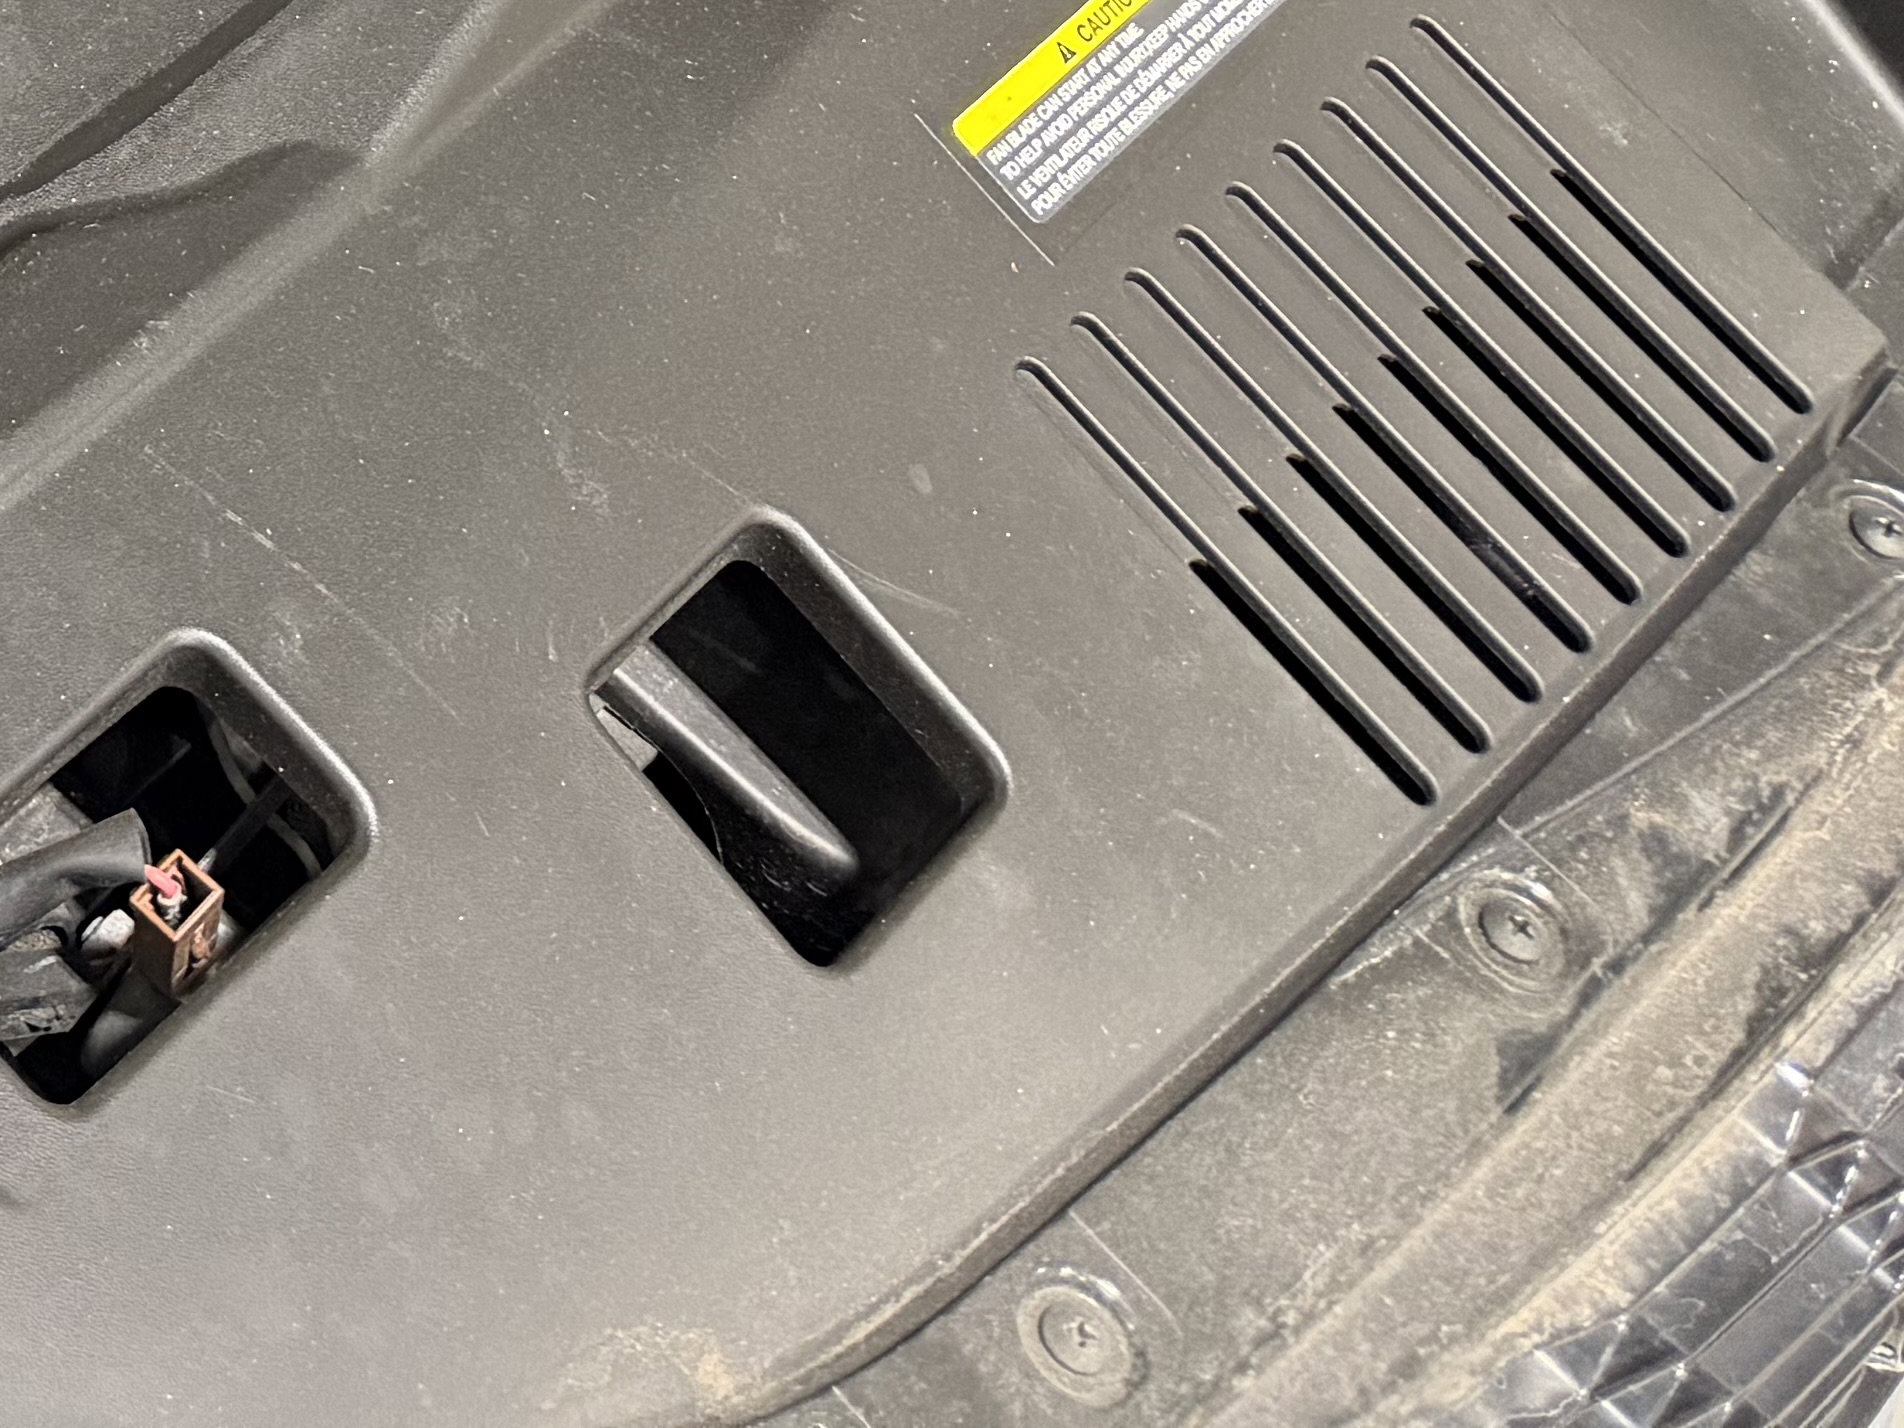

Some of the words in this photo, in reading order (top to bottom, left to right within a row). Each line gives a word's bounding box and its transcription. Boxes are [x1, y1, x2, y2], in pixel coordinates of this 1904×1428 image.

[1177, 32, 1196, 51] À
[1186, 13, 1217, 43] TOUT
[1132, 41, 1188, 94] DÉMARRER
[986, 139, 1013, 166] FAN
[1005, 112, 1044, 149] BLADE
[1036, 93, 1064, 121] CAN
[1057, 67, 1091, 103] START
[1085, 57, 1105, 78] AT
[1097, 40, 1121, 67] ANY
[1085, 95, 1128, 136] RISQUE
[1119, 83, 1141, 106] DE
[999, 160, 1021, 181] TO
[1014, 138, 1044, 169] HELP
[1040, 113, 1074, 148] AVOID
[1066, 71, 1122, 122] PERSONAL
[1030, 182, 1067, 216] POUR
[1056, 154, 1098, 191] ÉVITER
[1087, 126, 1126, 162] TOUTE
[1117, 84, 1175, 136] BLESSURE,
[1164, 70, 1187, 93] NE
[1177, 55, 1204, 81] PAS
[1195, 43, 1217, 65] EN
[1028, 127, 1095, 188] VENTILATEUR
[1016, 179, 1037, 200] LE
